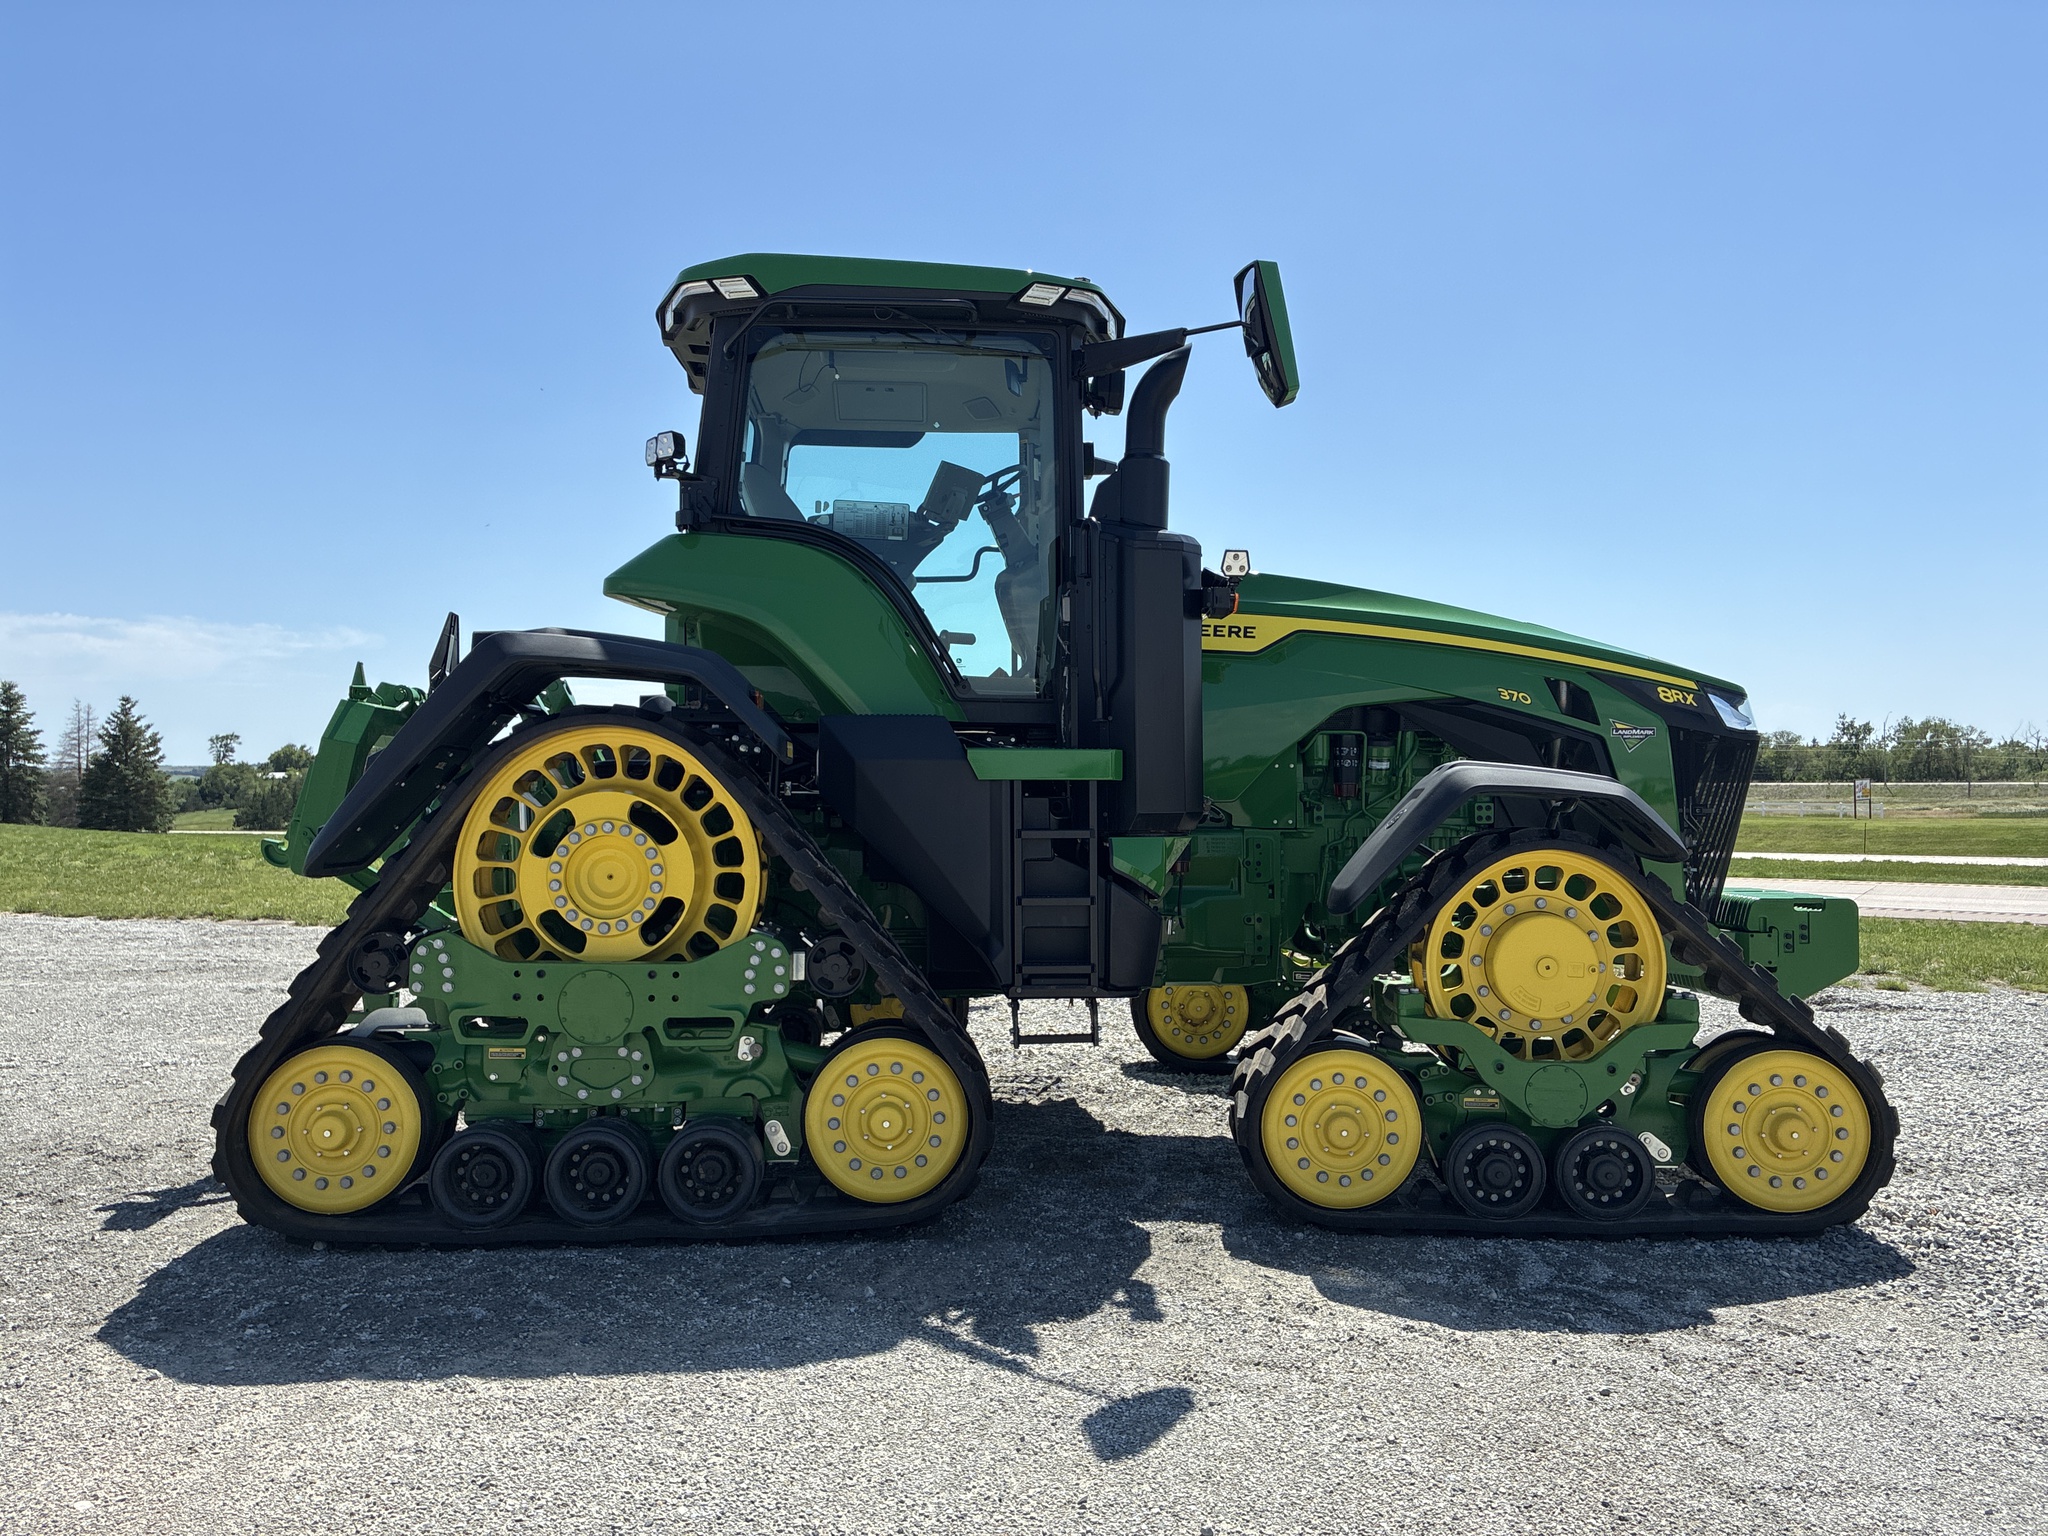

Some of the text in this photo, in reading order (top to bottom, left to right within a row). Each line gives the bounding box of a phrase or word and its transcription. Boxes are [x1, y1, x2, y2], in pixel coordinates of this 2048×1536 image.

[1202, 624, 1256, 639] EERE
[1497, 687, 1532, 705] 370
[1656, 686, 1698, 707] 8RX
